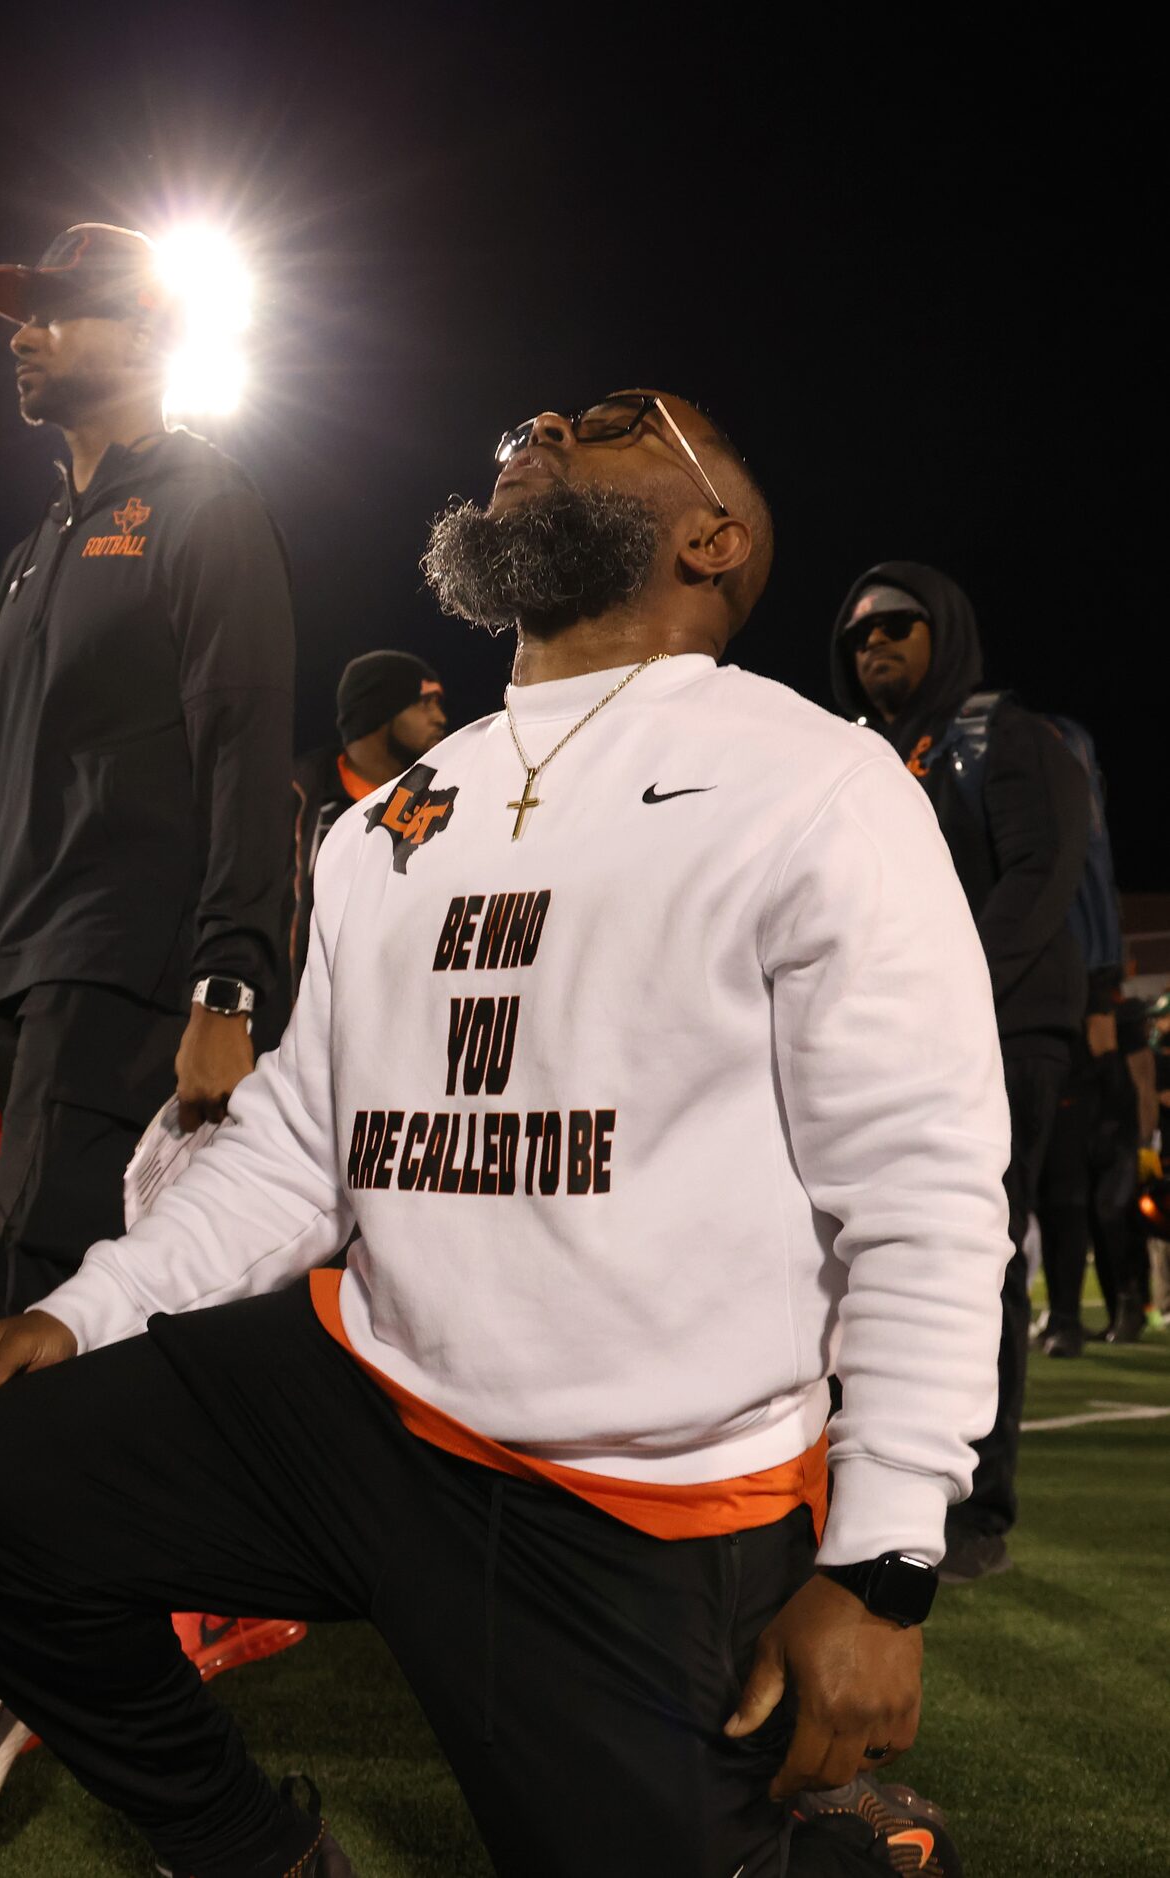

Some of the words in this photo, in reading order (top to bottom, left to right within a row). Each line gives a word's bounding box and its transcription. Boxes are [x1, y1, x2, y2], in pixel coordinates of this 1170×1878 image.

[81, 534, 147, 557] FOOTBALL
[432, 895, 486, 971] BE
[474, 889, 552, 970] WHO
[445, 996, 521, 1096] YOU
[347, 1110, 406, 1190] ARE
[397, 1111, 521, 1195] CALLED
[524, 1110, 562, 1195] TO
[566, 1108, 617, 1194] BE
